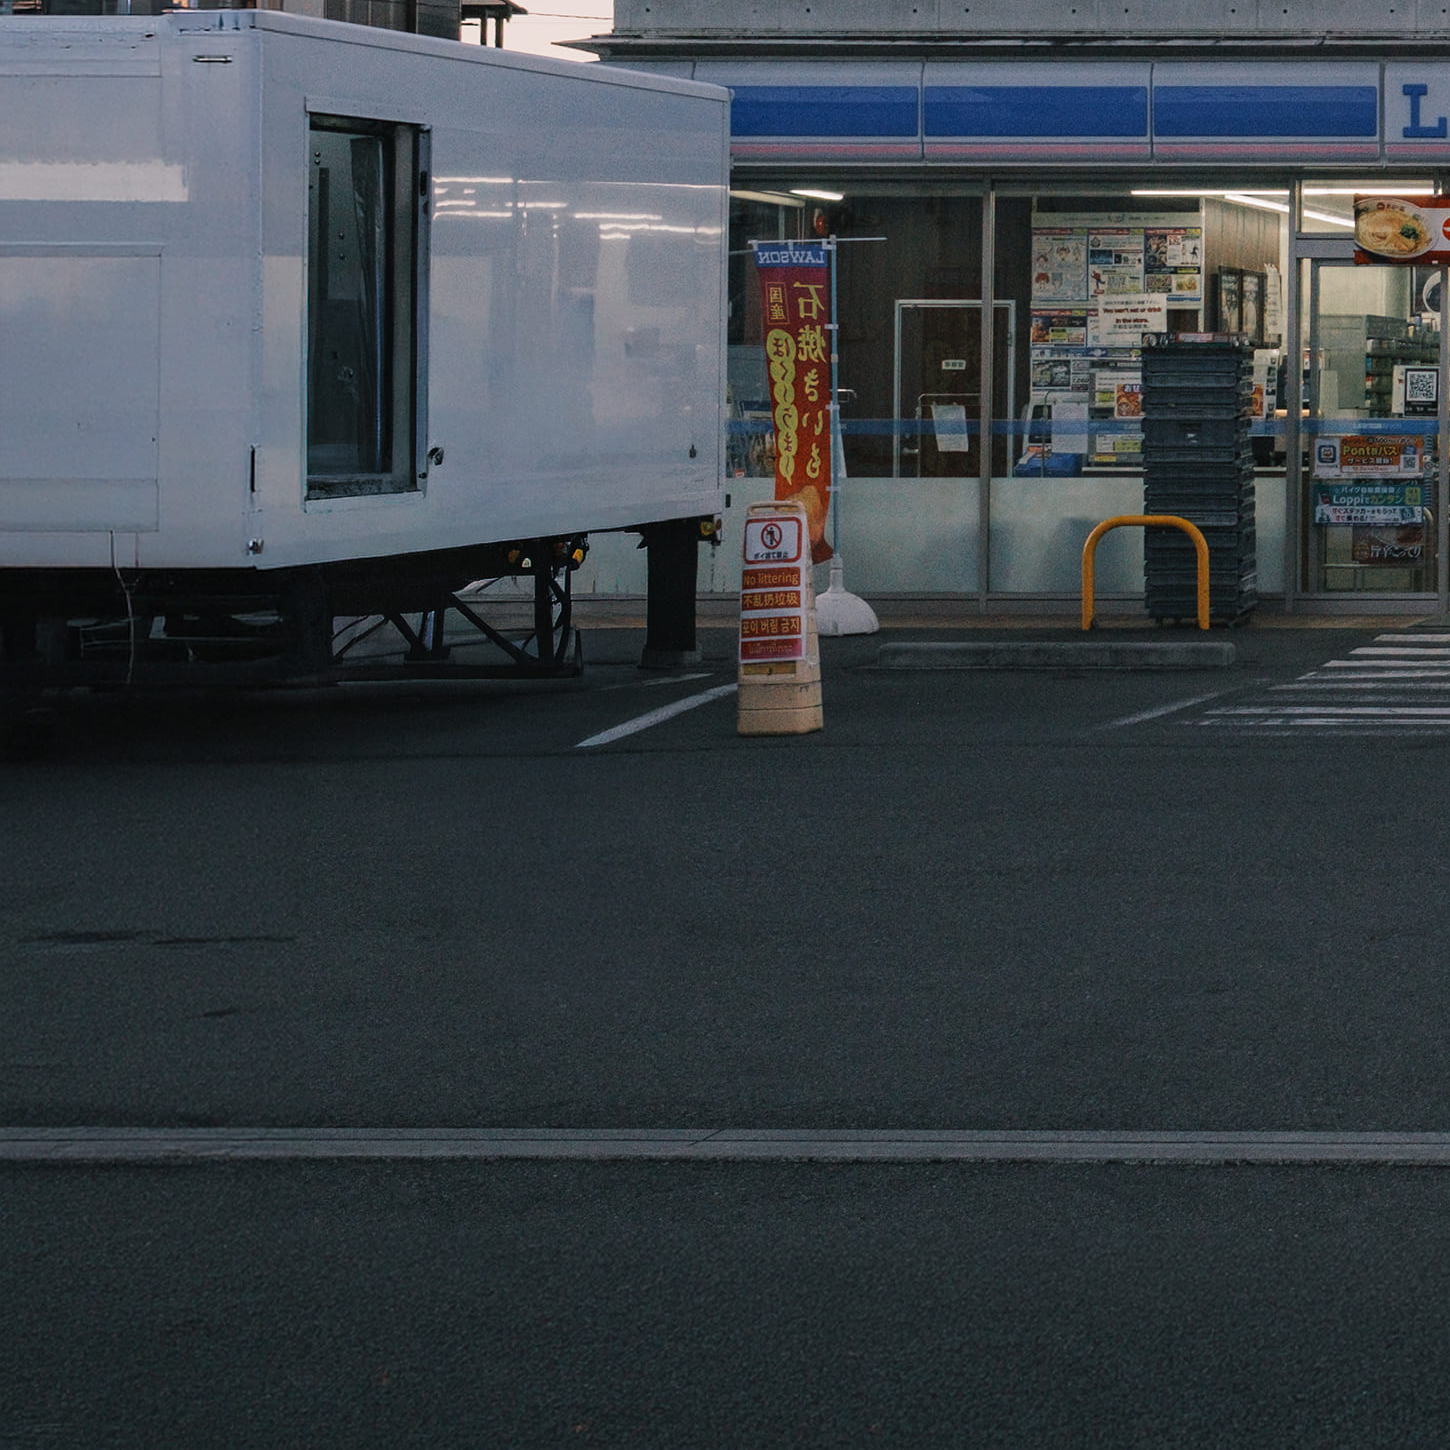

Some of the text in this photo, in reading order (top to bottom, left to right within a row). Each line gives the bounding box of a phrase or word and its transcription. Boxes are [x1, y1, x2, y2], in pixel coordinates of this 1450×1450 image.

[743, 572, 799, 586] No littering
[780, 617, 800, 632] 금지
